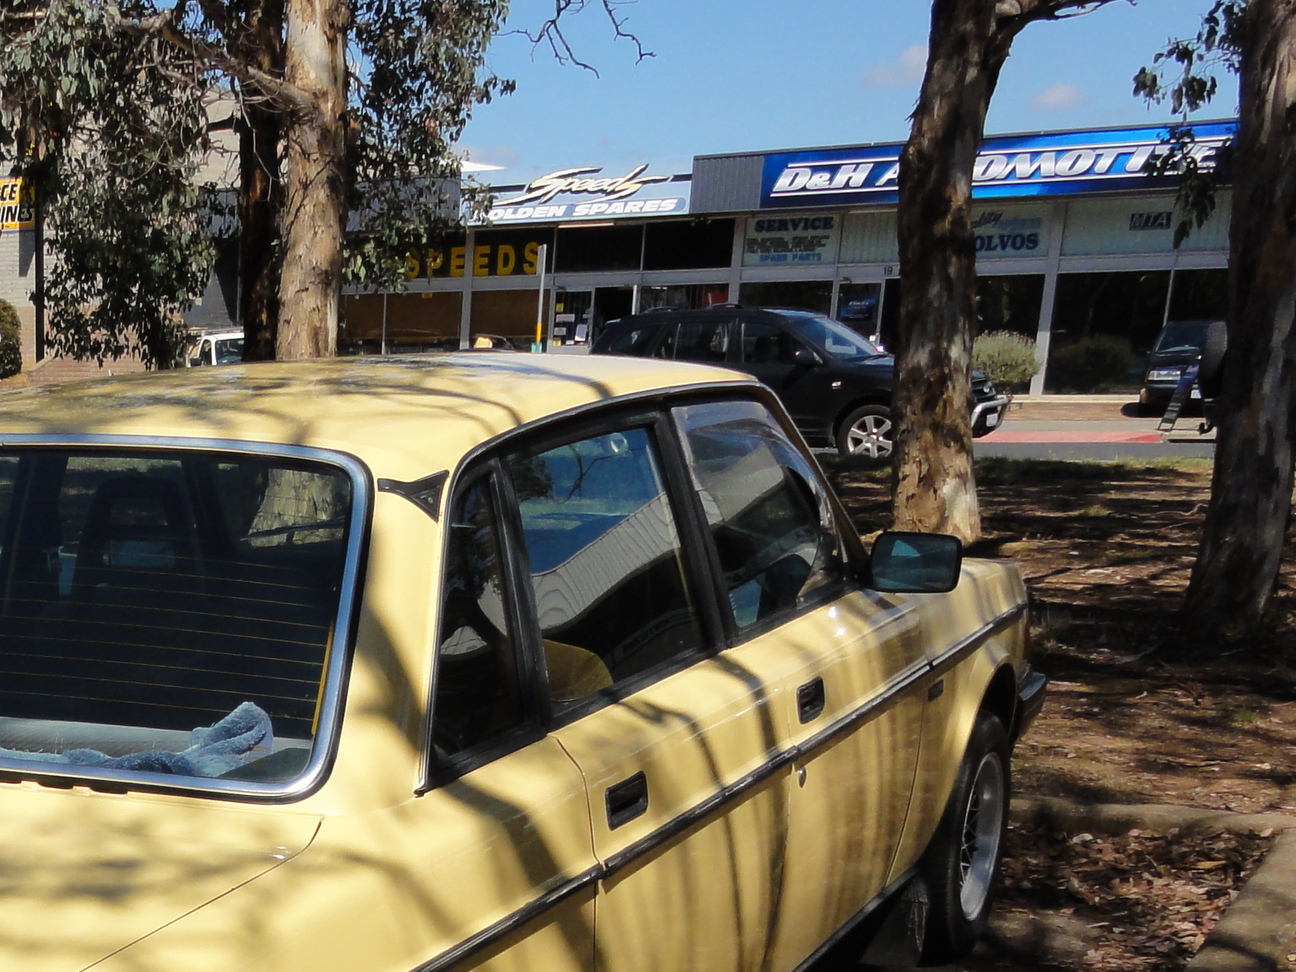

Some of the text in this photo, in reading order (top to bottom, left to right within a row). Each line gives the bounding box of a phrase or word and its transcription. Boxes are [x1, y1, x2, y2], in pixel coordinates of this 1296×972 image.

[491, 163, 672, 207] Speeds
[772, 163, 874, 192] D&H
[572, 199, 678, 217] SPARES
[755, 216, 834, 233] SERVICE
[972, 231, 1039, 252] OLVOS
[883, 266, 894, 276] 19
